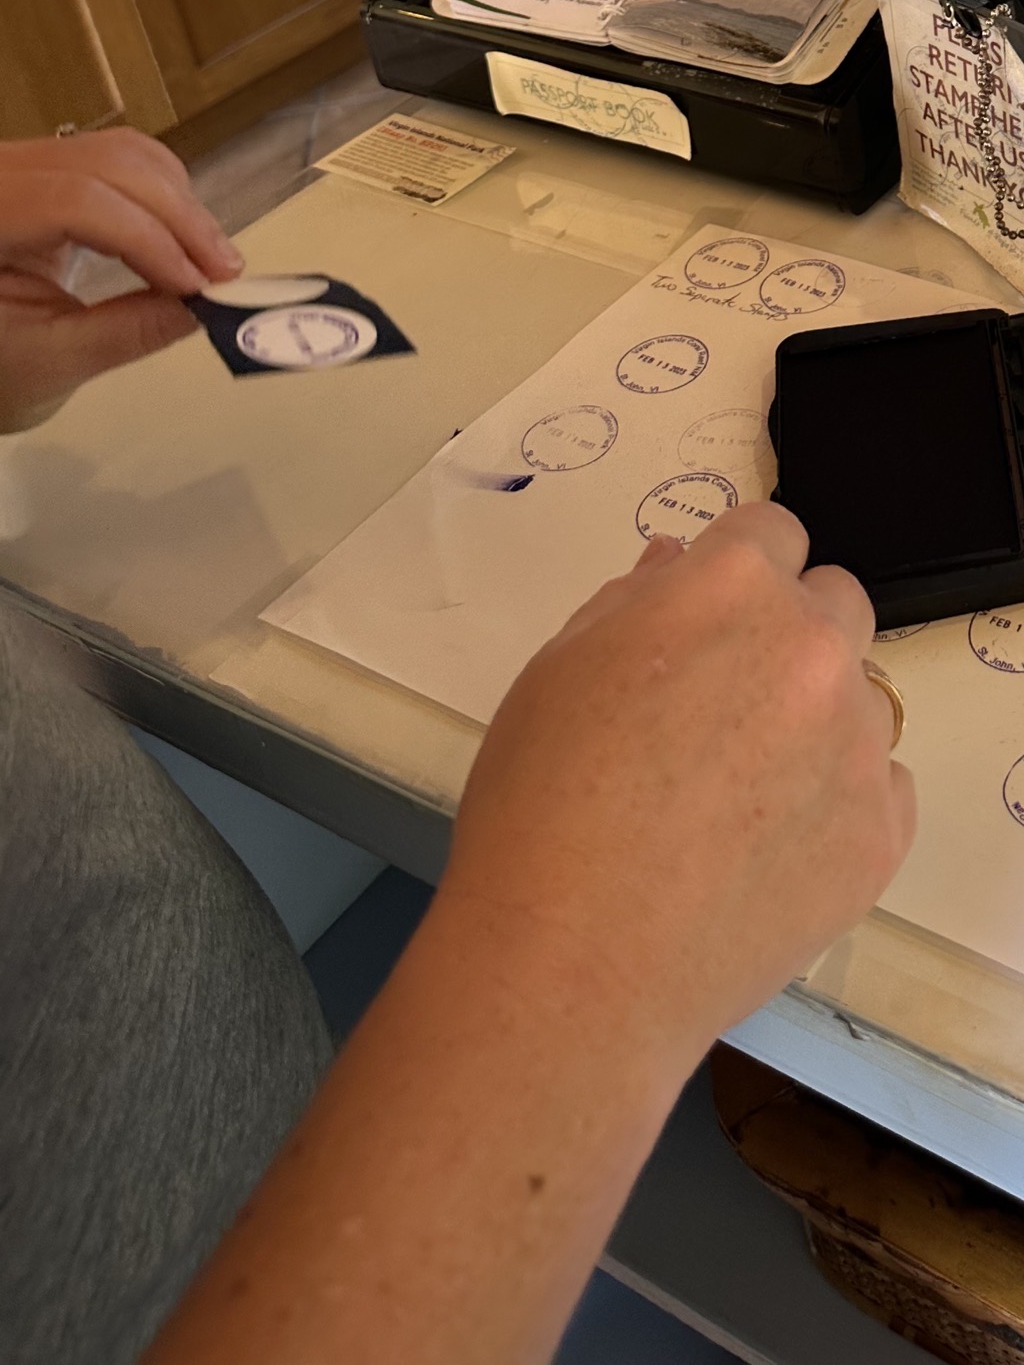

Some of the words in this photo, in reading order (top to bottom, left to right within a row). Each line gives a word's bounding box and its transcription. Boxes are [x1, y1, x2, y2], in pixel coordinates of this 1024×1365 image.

[603, 101, 655, 124] BOOK
[651, 481, 676, 498] Virgin
[678, 475, 710, 484] Islands
[711, 477, 731, 493] Coral
[658, 497, 678, 508] FEB
[694, 509, 715, 521] 2023
[989, 615, 1011, 629] FEB
[989, 657, 1016, 672] John,
